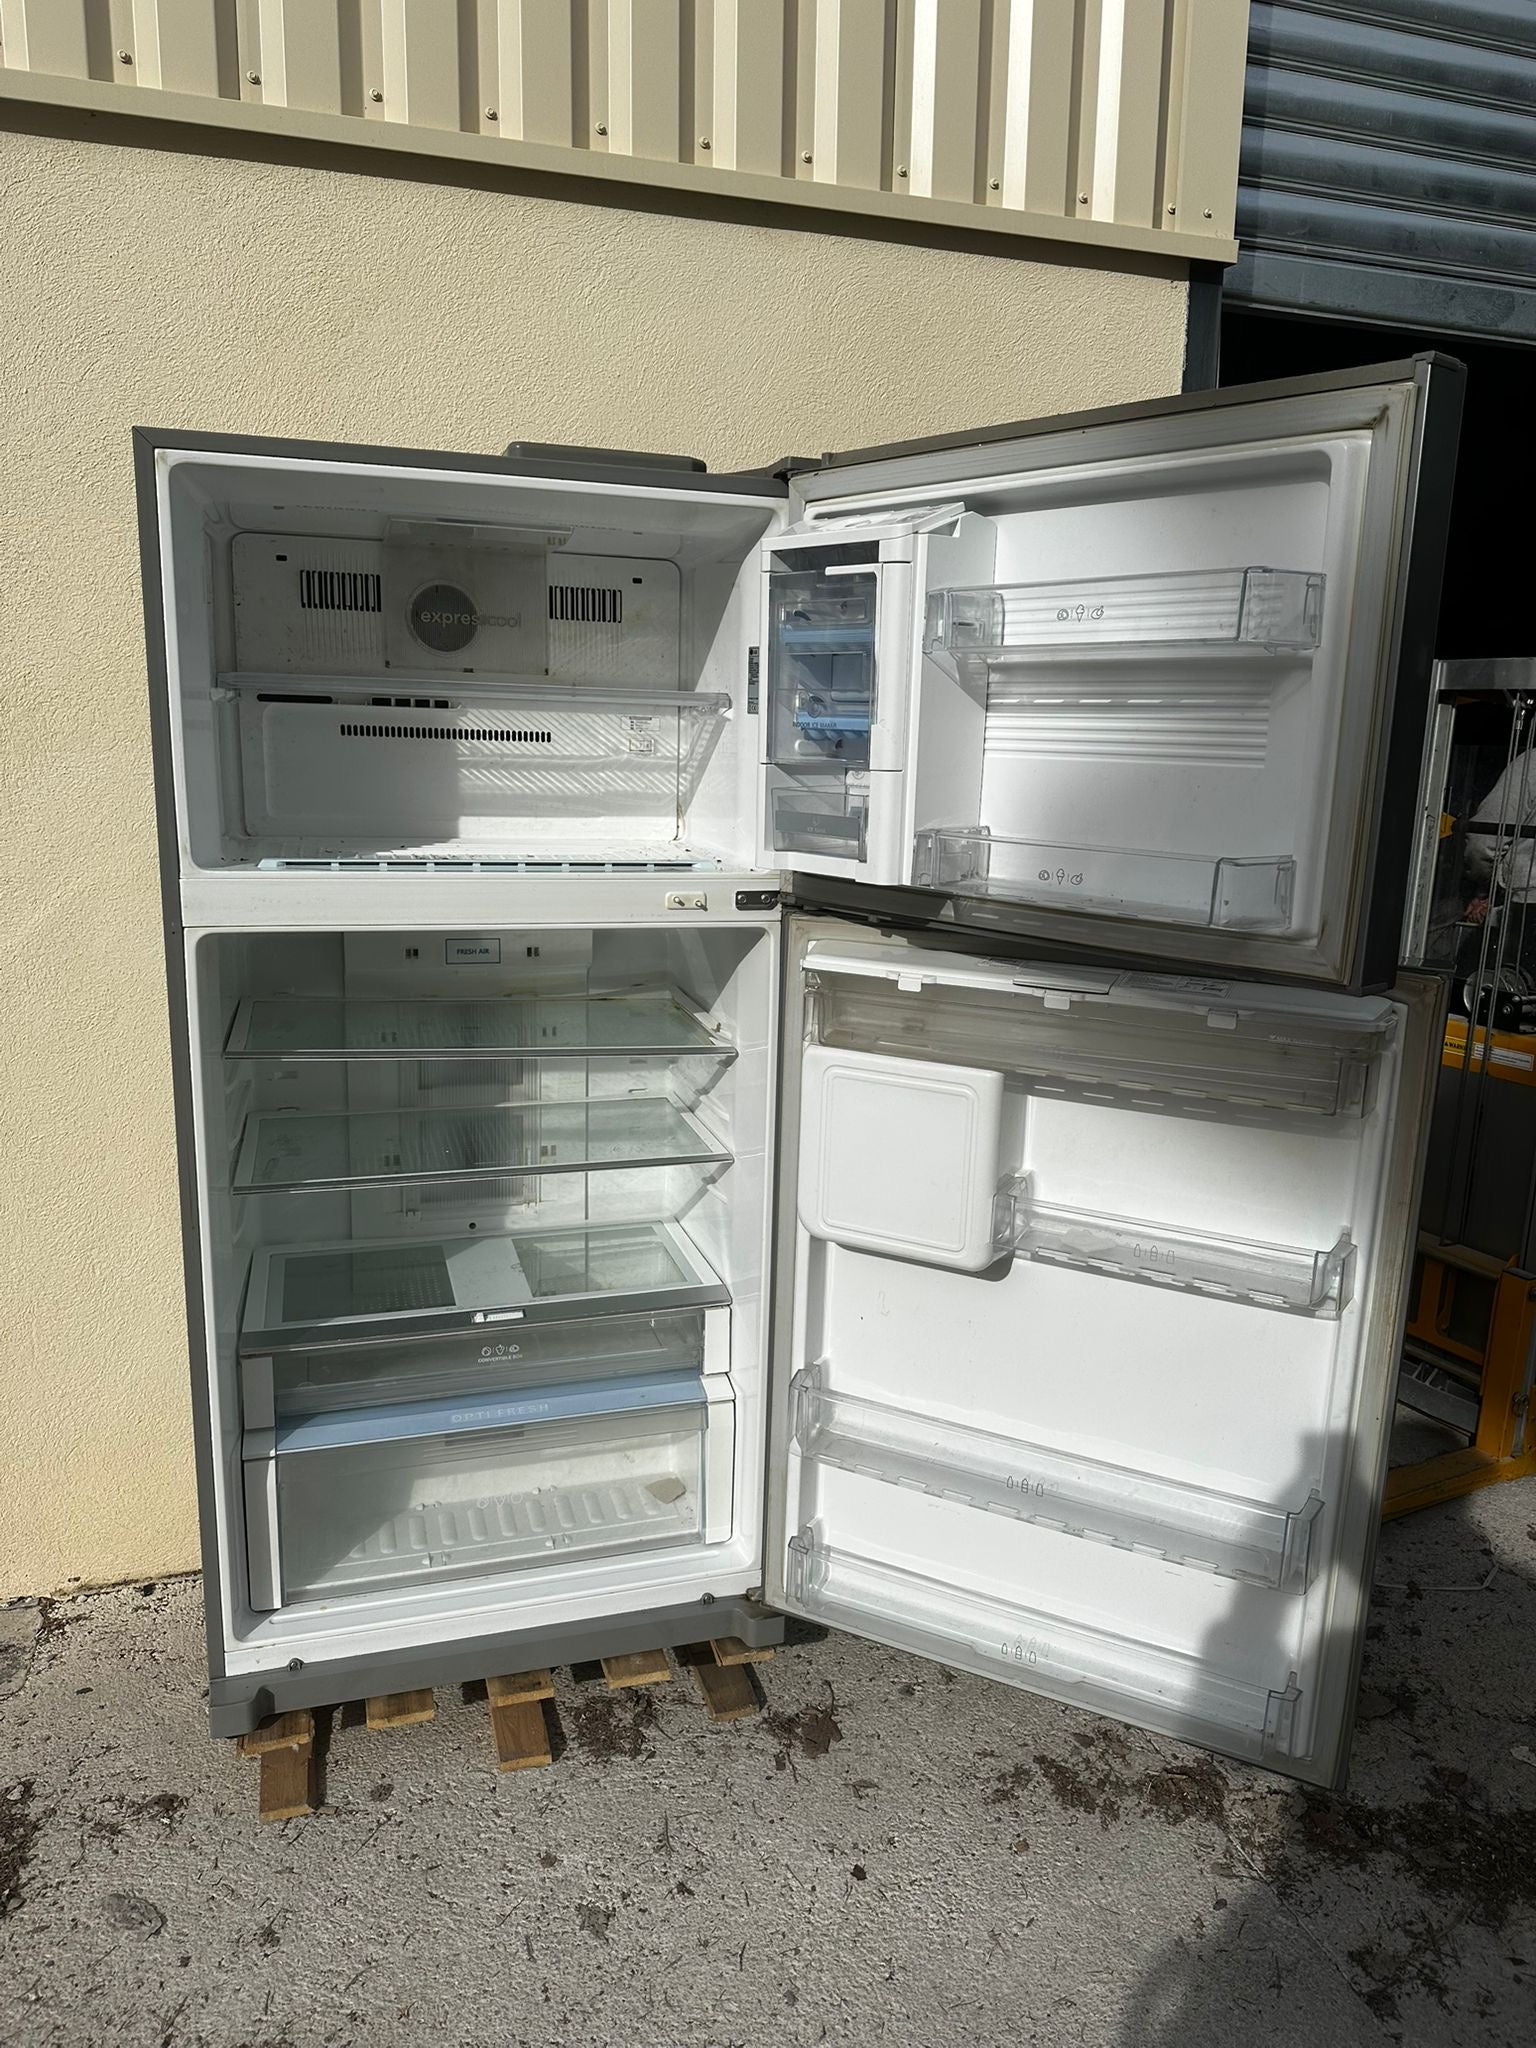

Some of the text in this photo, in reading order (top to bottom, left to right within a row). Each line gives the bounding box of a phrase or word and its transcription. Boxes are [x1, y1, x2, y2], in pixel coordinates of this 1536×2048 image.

[456, 947, 490, 956] FRESH AIR
[451, 1403, 550, 1423] OPTI FRESH
